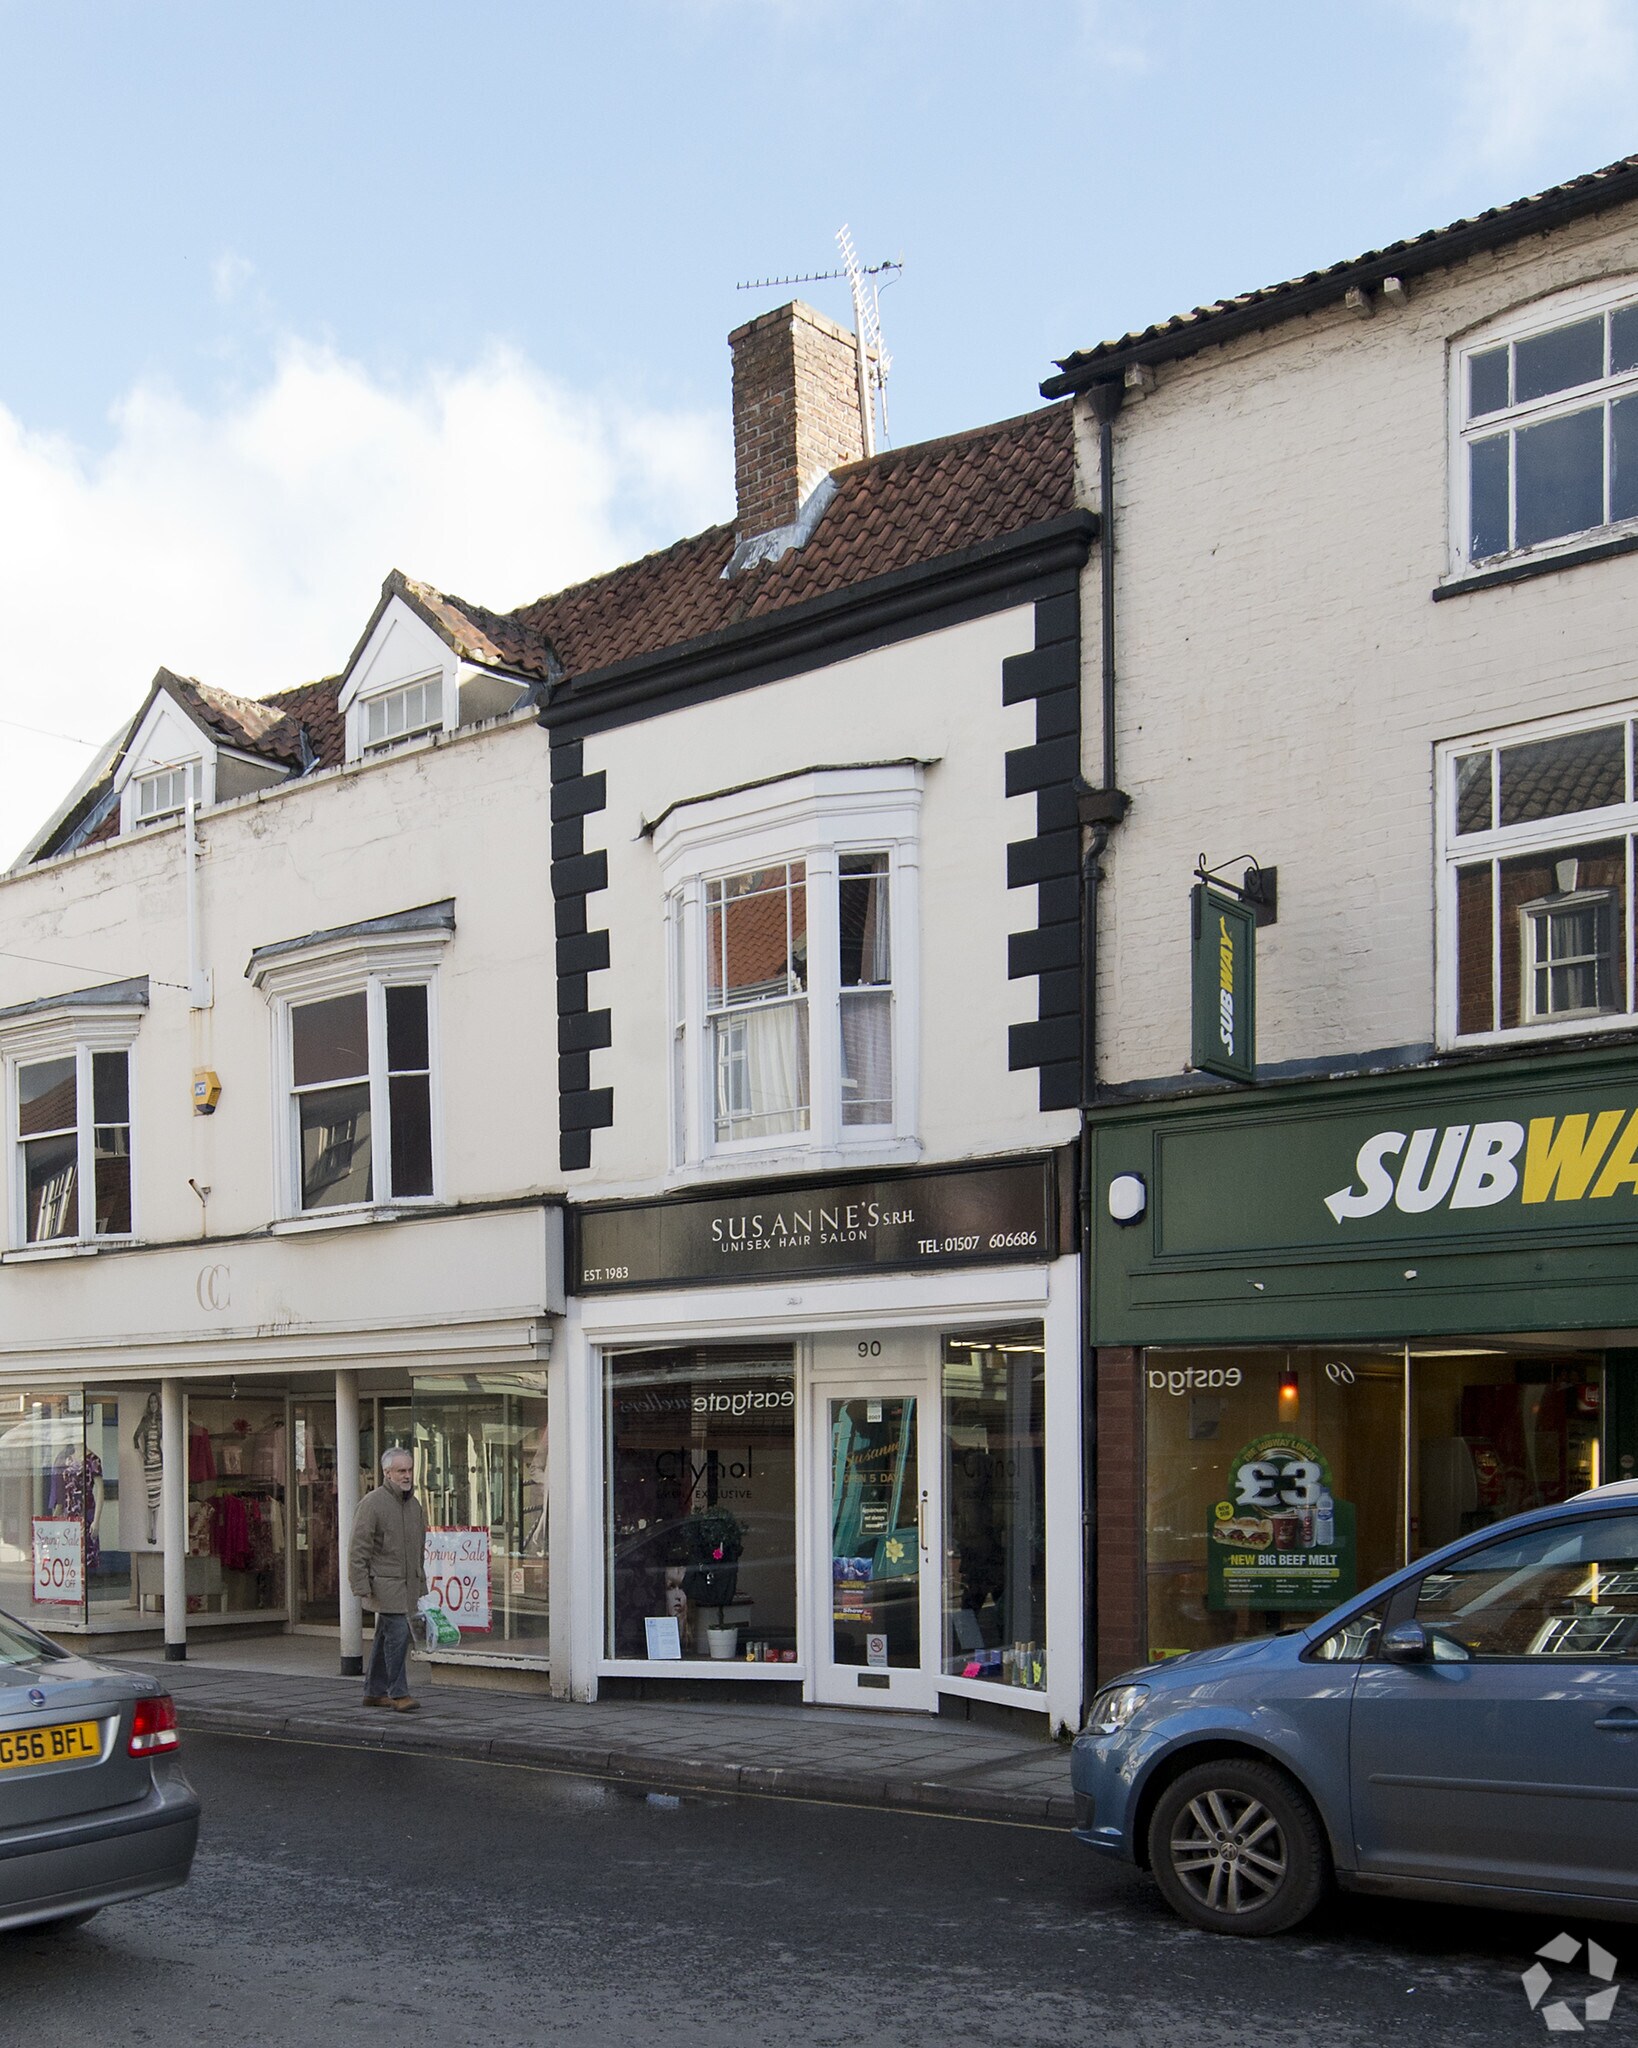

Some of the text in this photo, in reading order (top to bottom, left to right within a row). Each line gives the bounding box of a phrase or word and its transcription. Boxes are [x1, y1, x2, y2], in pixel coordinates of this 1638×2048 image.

[1219, 915, 1234, 1057] SUBWAY
[711, 1201, 880, 1242] SUSANNE'S
[721, 1229, 868, 1253] UNISEX HAIR SALON
[989, 1230, 1037, 1249] 606686
[584, 1266, 629, 1281] EST. 1983
[857, 1340, 882, 1358] 90
[869, 1473, 877, 1483] 5
[1235, 1460, 1322, 1507] £3
[695, 1489, 753, 1499] EXLUSIVE
[36, 1527, 80, 1550] Spring Sale
[424, 1539, 485, 1567] Spring Sale
[1230, 1554, 1338, 1566] NEW BIG BEEF MELT
[39, 1557, 76, 1588] 50%
[64, 1579, 76, 1588] OFF
[429, 1575, 480, 1612] 50%
[464, 1601, 480, 1612] OFF
[0, 1727, 93, 1764] G56 BFL
